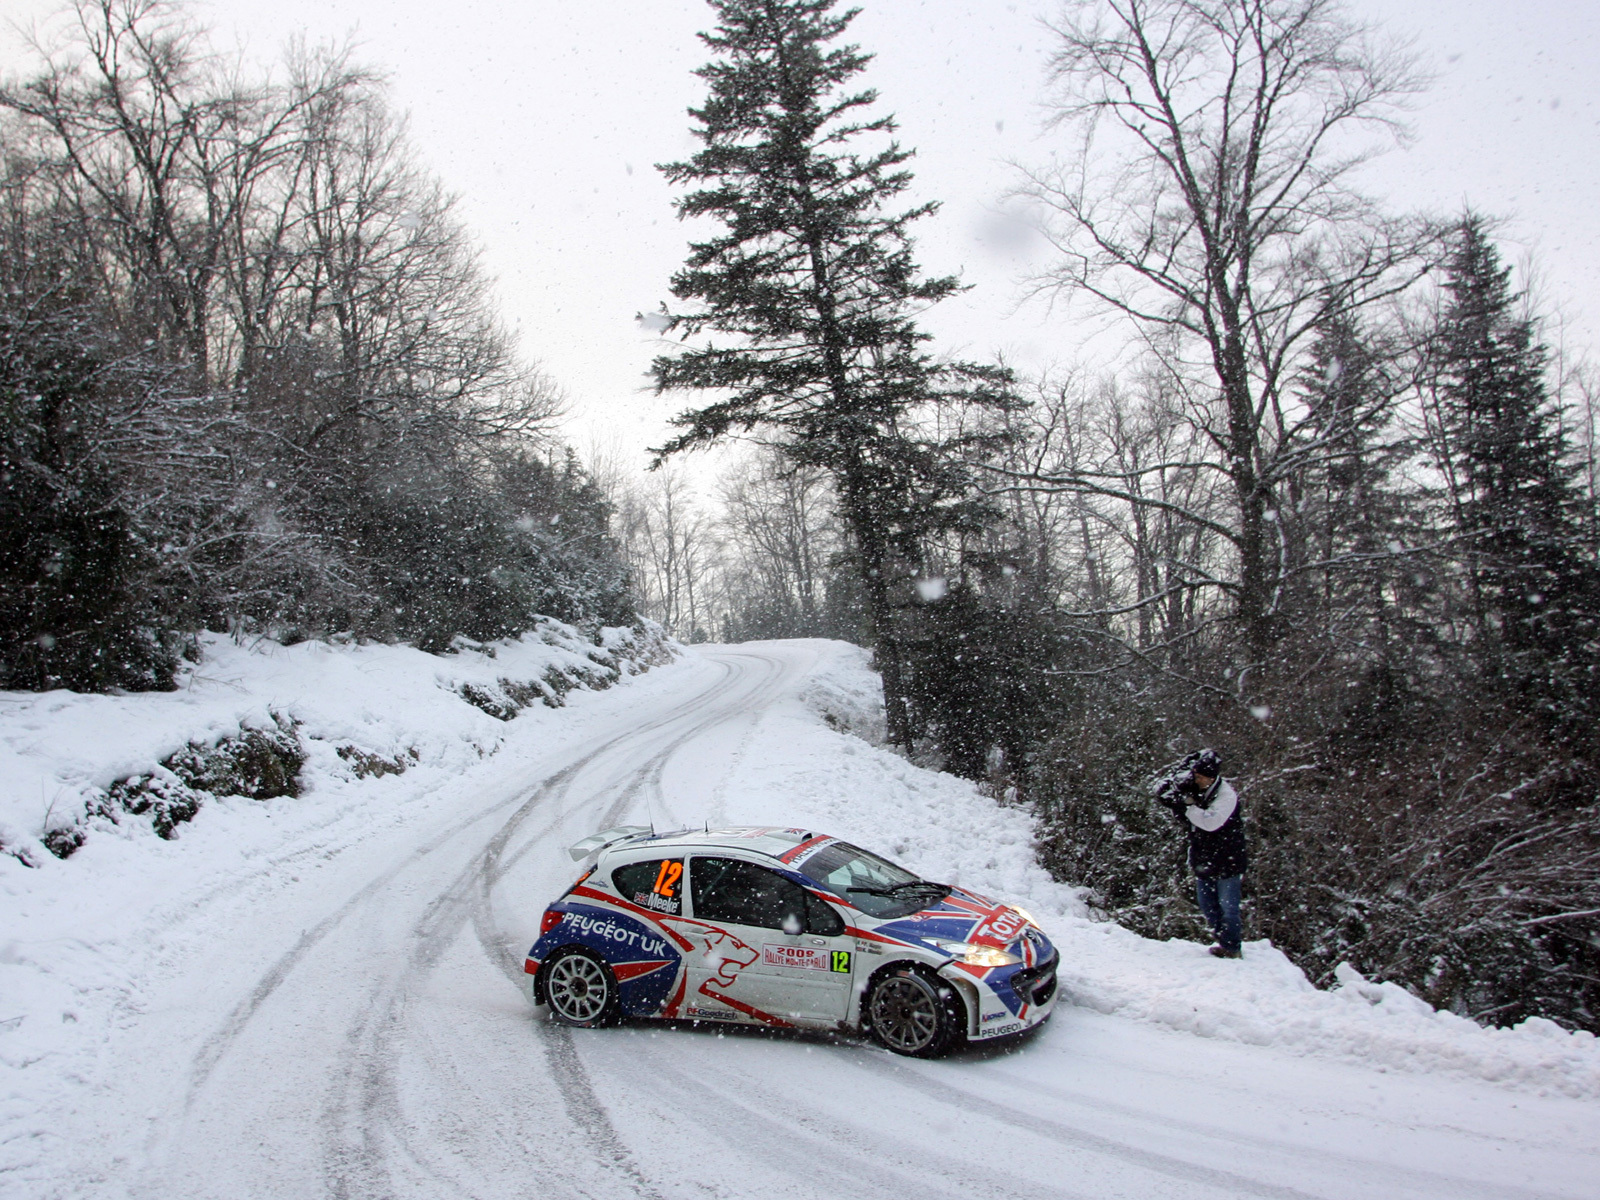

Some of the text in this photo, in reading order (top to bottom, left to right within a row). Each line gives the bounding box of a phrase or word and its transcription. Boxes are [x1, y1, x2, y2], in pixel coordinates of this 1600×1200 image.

[653, 860, 683, 897] 12
[648, 892, 678, 913] Meeke
[562, 912, 667, 957] PEUGEOT UK
[765, 948, 784, 965] RALLYE
[777, 947, 815, 958] 2009
[832, 951, 849, 973] 12
